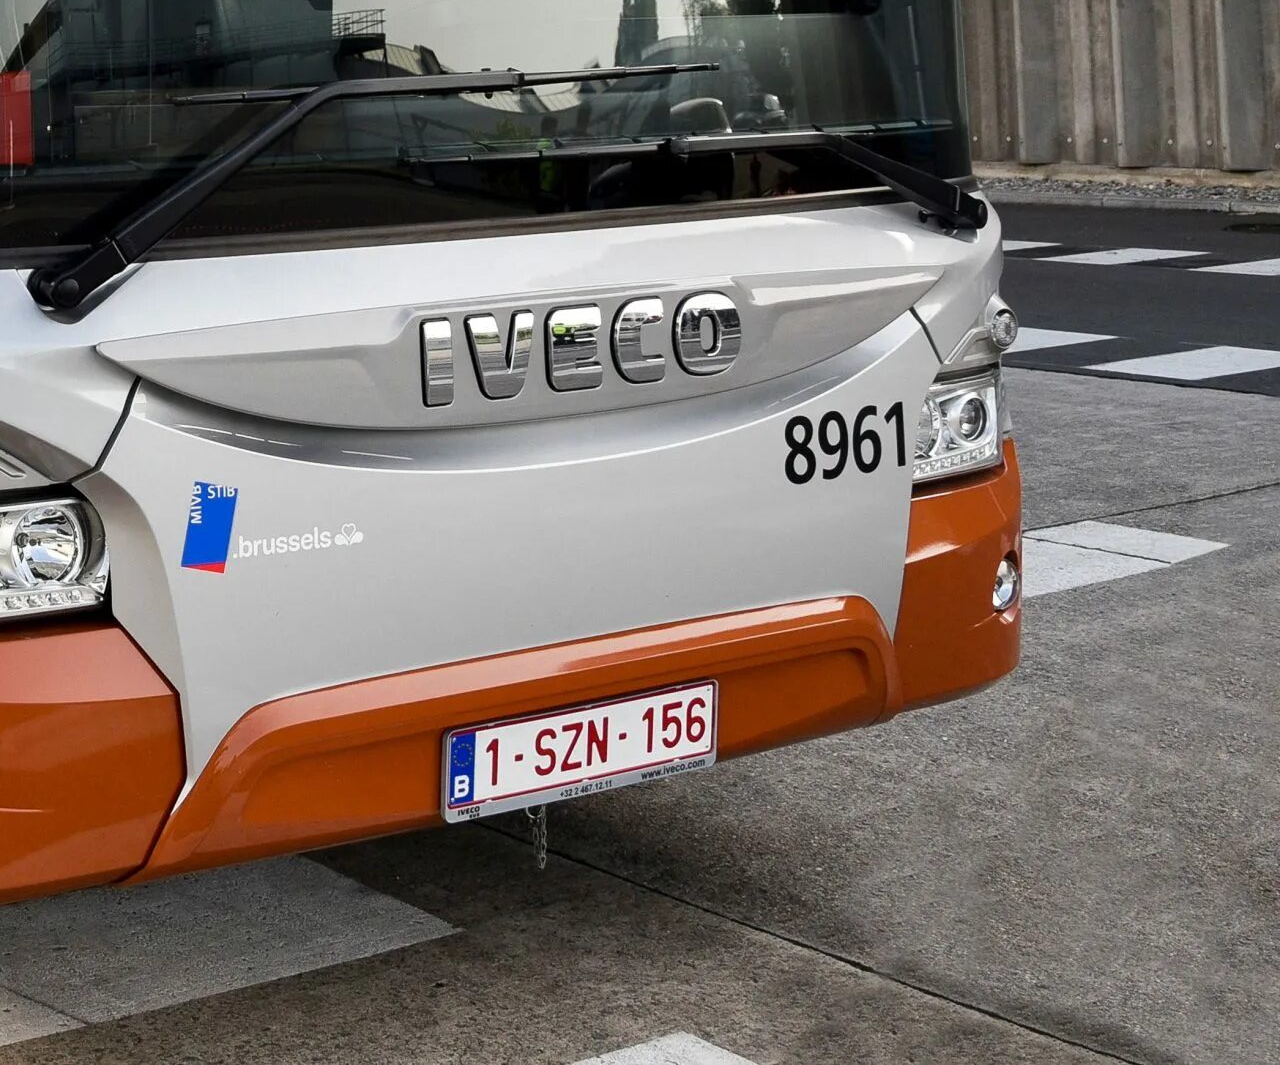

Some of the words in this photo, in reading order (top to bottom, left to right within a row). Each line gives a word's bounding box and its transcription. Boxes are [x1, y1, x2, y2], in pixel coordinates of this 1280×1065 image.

[419, 290, 742, 408] IVECO
[784, 401, 907, 485] 8961
[207, 485, 235, 499] STIB
[190, 485, 202, 524] MIVB
[232, 527, 332, 559] .brussels
[641, 759, 706, 780] www.iveco.com
[453, 774, 470, 798] B
[560, 788, 573, 798] +32
[457, 805, 480, 817] IVECO
